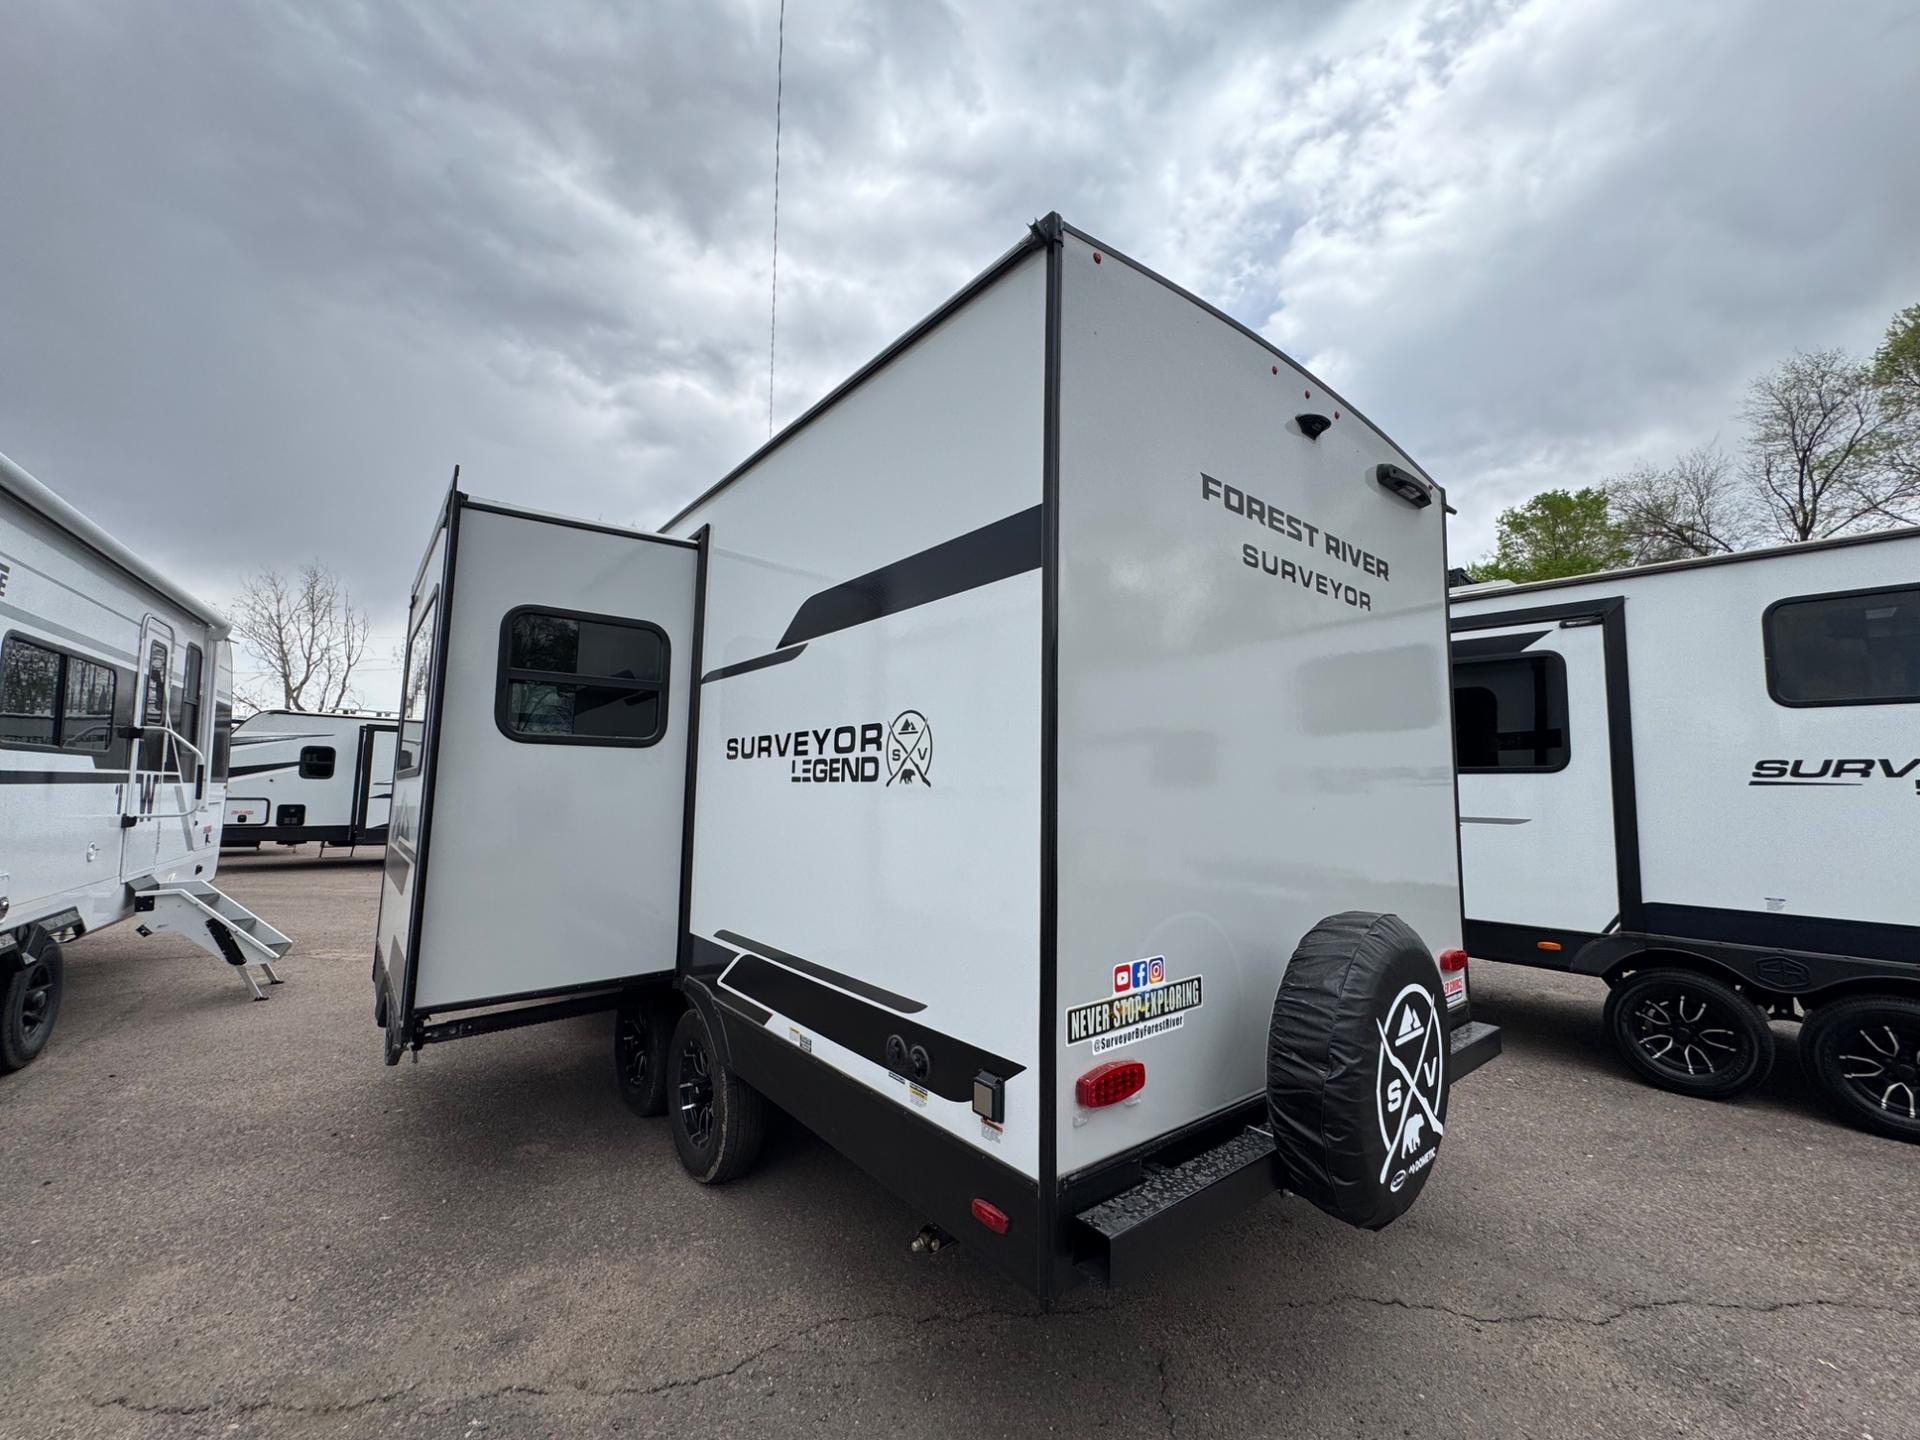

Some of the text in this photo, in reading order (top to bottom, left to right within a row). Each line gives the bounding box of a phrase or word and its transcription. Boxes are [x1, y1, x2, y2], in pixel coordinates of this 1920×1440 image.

[1200, 472, 1390, 582] FOREST RIVER
[1242, 544, 1372, 612] SURVEYOR
[726, 722, 883, 760] SURVEYOR
[791, 756, 880, 783] LEGEND
[1751, 758, 1920, 778] SURV
[1071, 979, 1200, 1040] NEVER STOP EXPLORING
[1094, 1015, 1183, 1052] @SurveyorByForestRiver
[1387, 1056, 1437, 1112] S V
